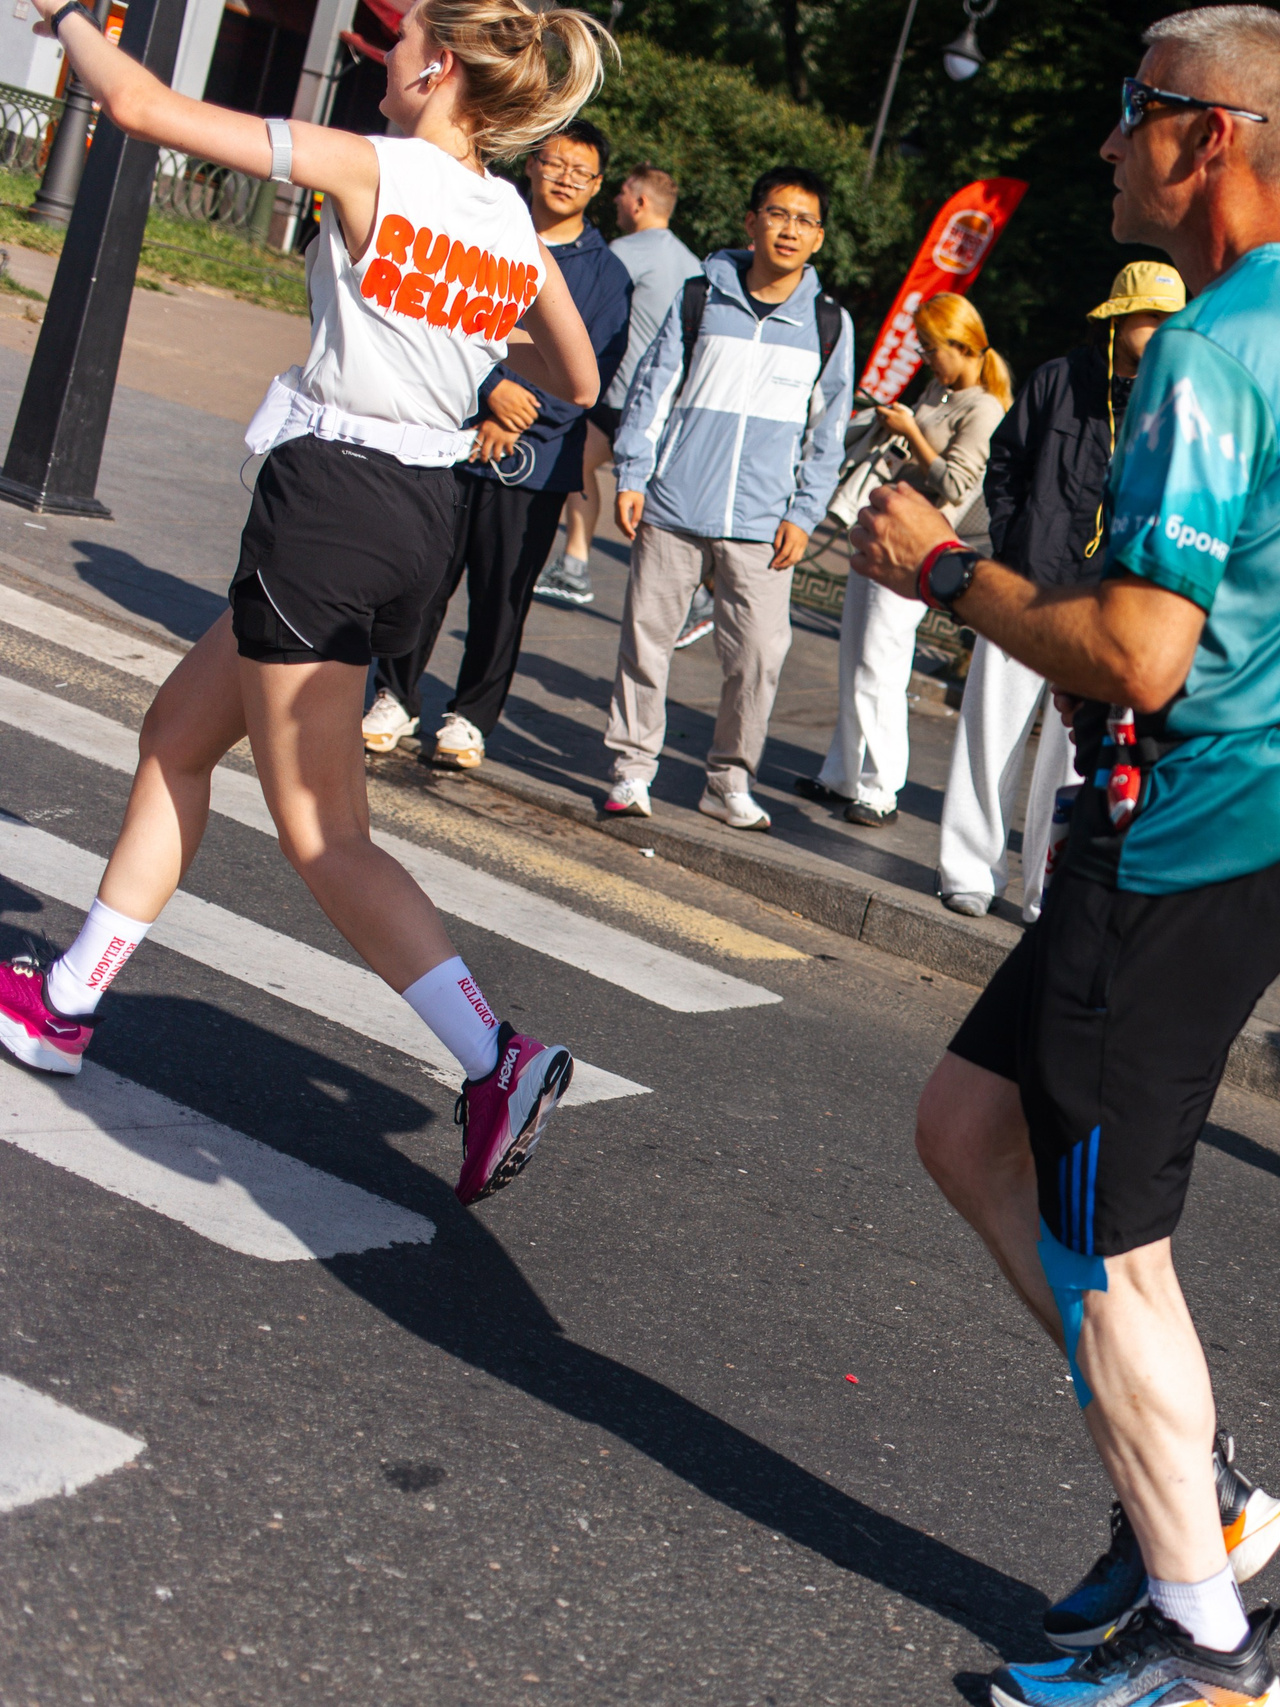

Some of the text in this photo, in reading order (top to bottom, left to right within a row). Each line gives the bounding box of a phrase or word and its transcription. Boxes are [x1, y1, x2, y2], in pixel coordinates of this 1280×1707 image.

[376, 214, 538, 307] RUNNING
[360, 258, 525, 343] RELIGIO
[84, 935, 127, 991] RELIGION
[457, 977, 497, 1031] RELIGION
[497, 1047, 521, 1091] HOKA
